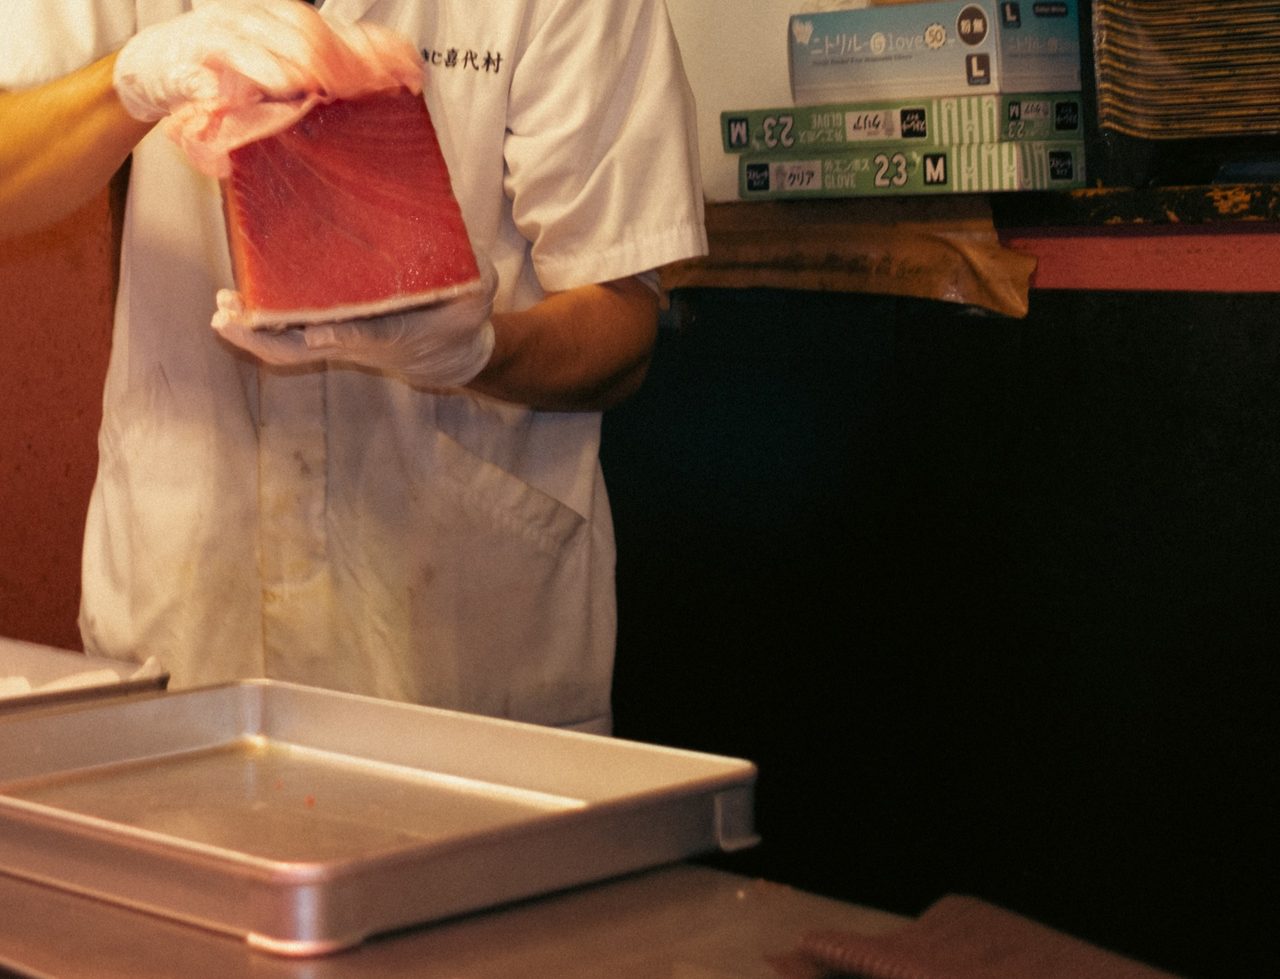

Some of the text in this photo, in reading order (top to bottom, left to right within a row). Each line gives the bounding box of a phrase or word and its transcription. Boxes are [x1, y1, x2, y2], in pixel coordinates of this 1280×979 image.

[1004, 2, 1017, 23] L
[928, 29, 943, 43] 50
[971, 56, 985, 77] L
[730, 121, 748, 146] M
[762, 116, 795, 148] 23
[873, 153, 908, 188] 23
[925, 156, 945, 183] M
